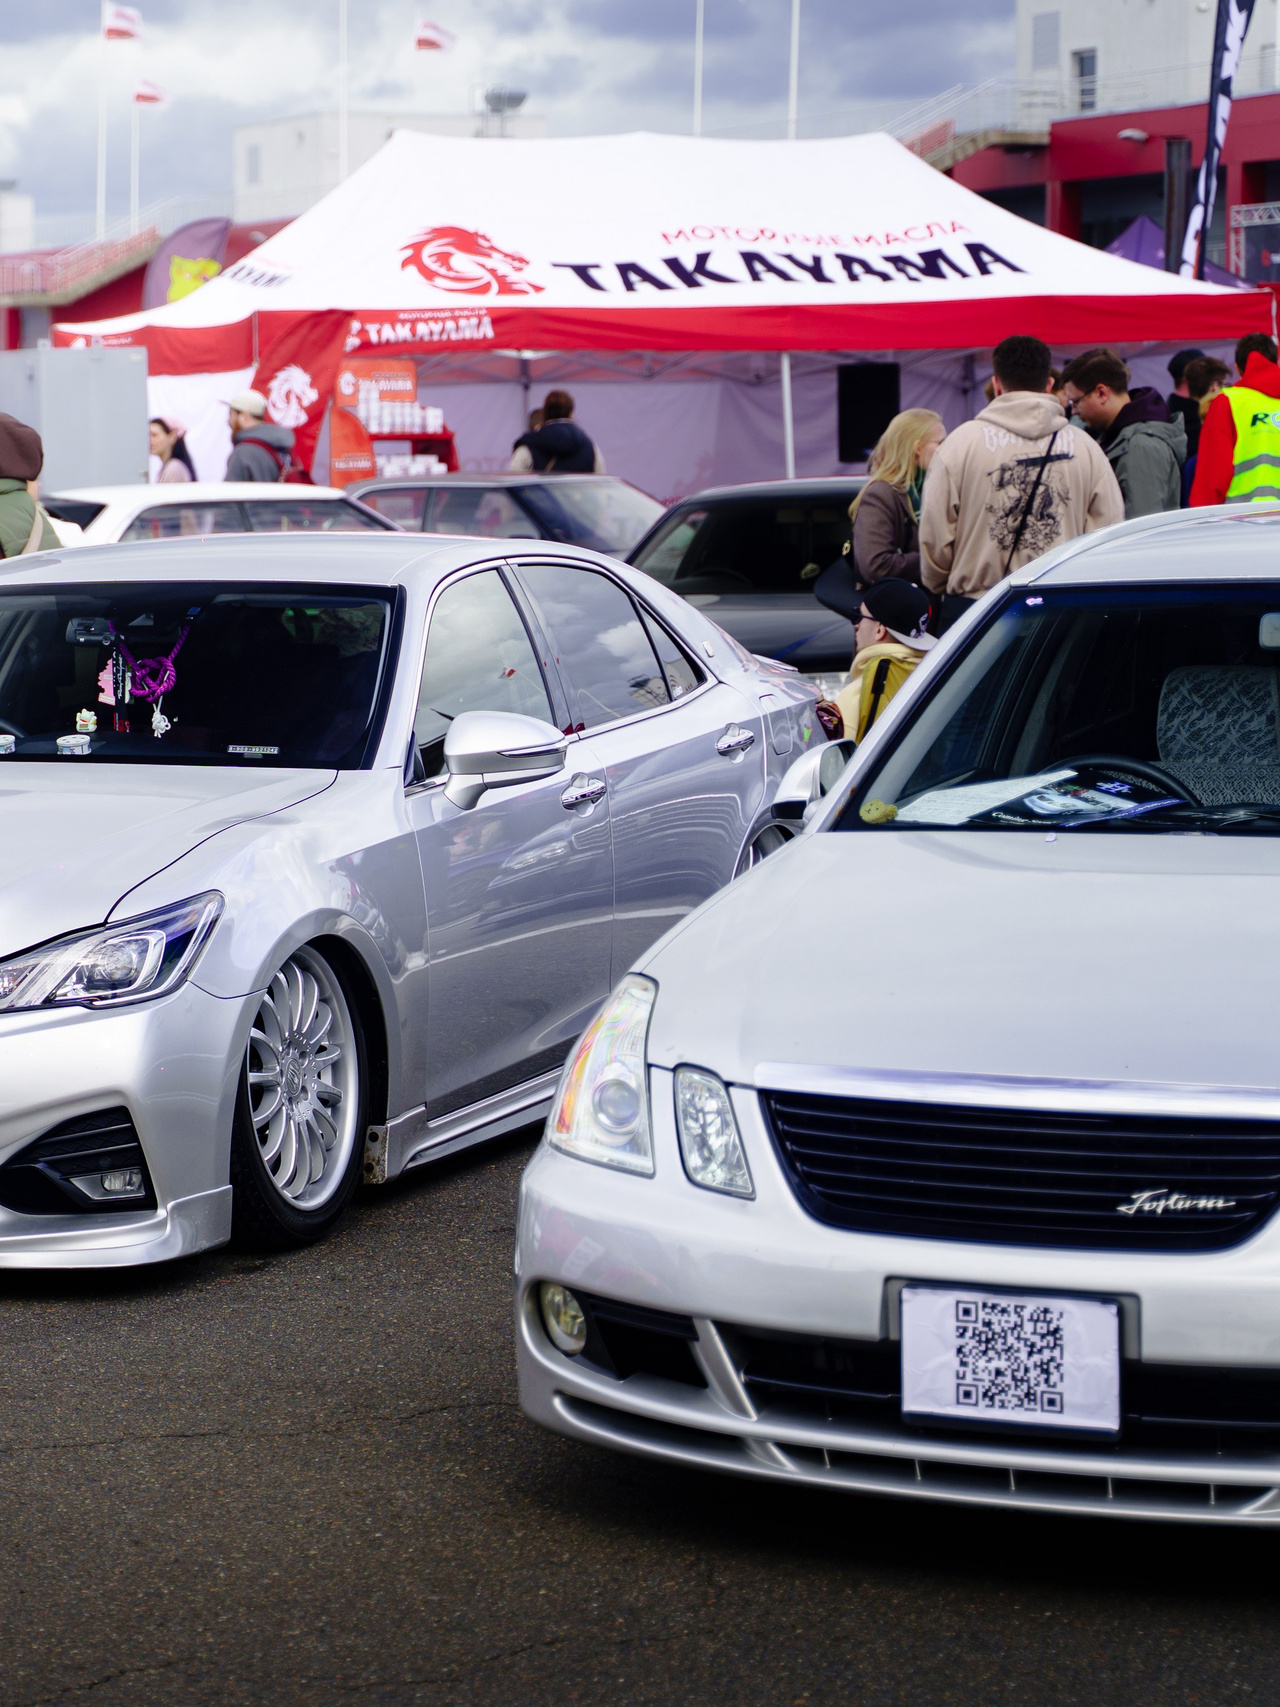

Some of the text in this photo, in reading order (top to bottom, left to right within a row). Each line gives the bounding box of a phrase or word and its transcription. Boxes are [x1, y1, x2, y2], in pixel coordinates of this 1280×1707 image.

[852, 220, 970, 246] МАСЛА
[552, 241, 1028, 292] TAKAYAMA
[364, 316, 495, 345] TAKAYAMA
